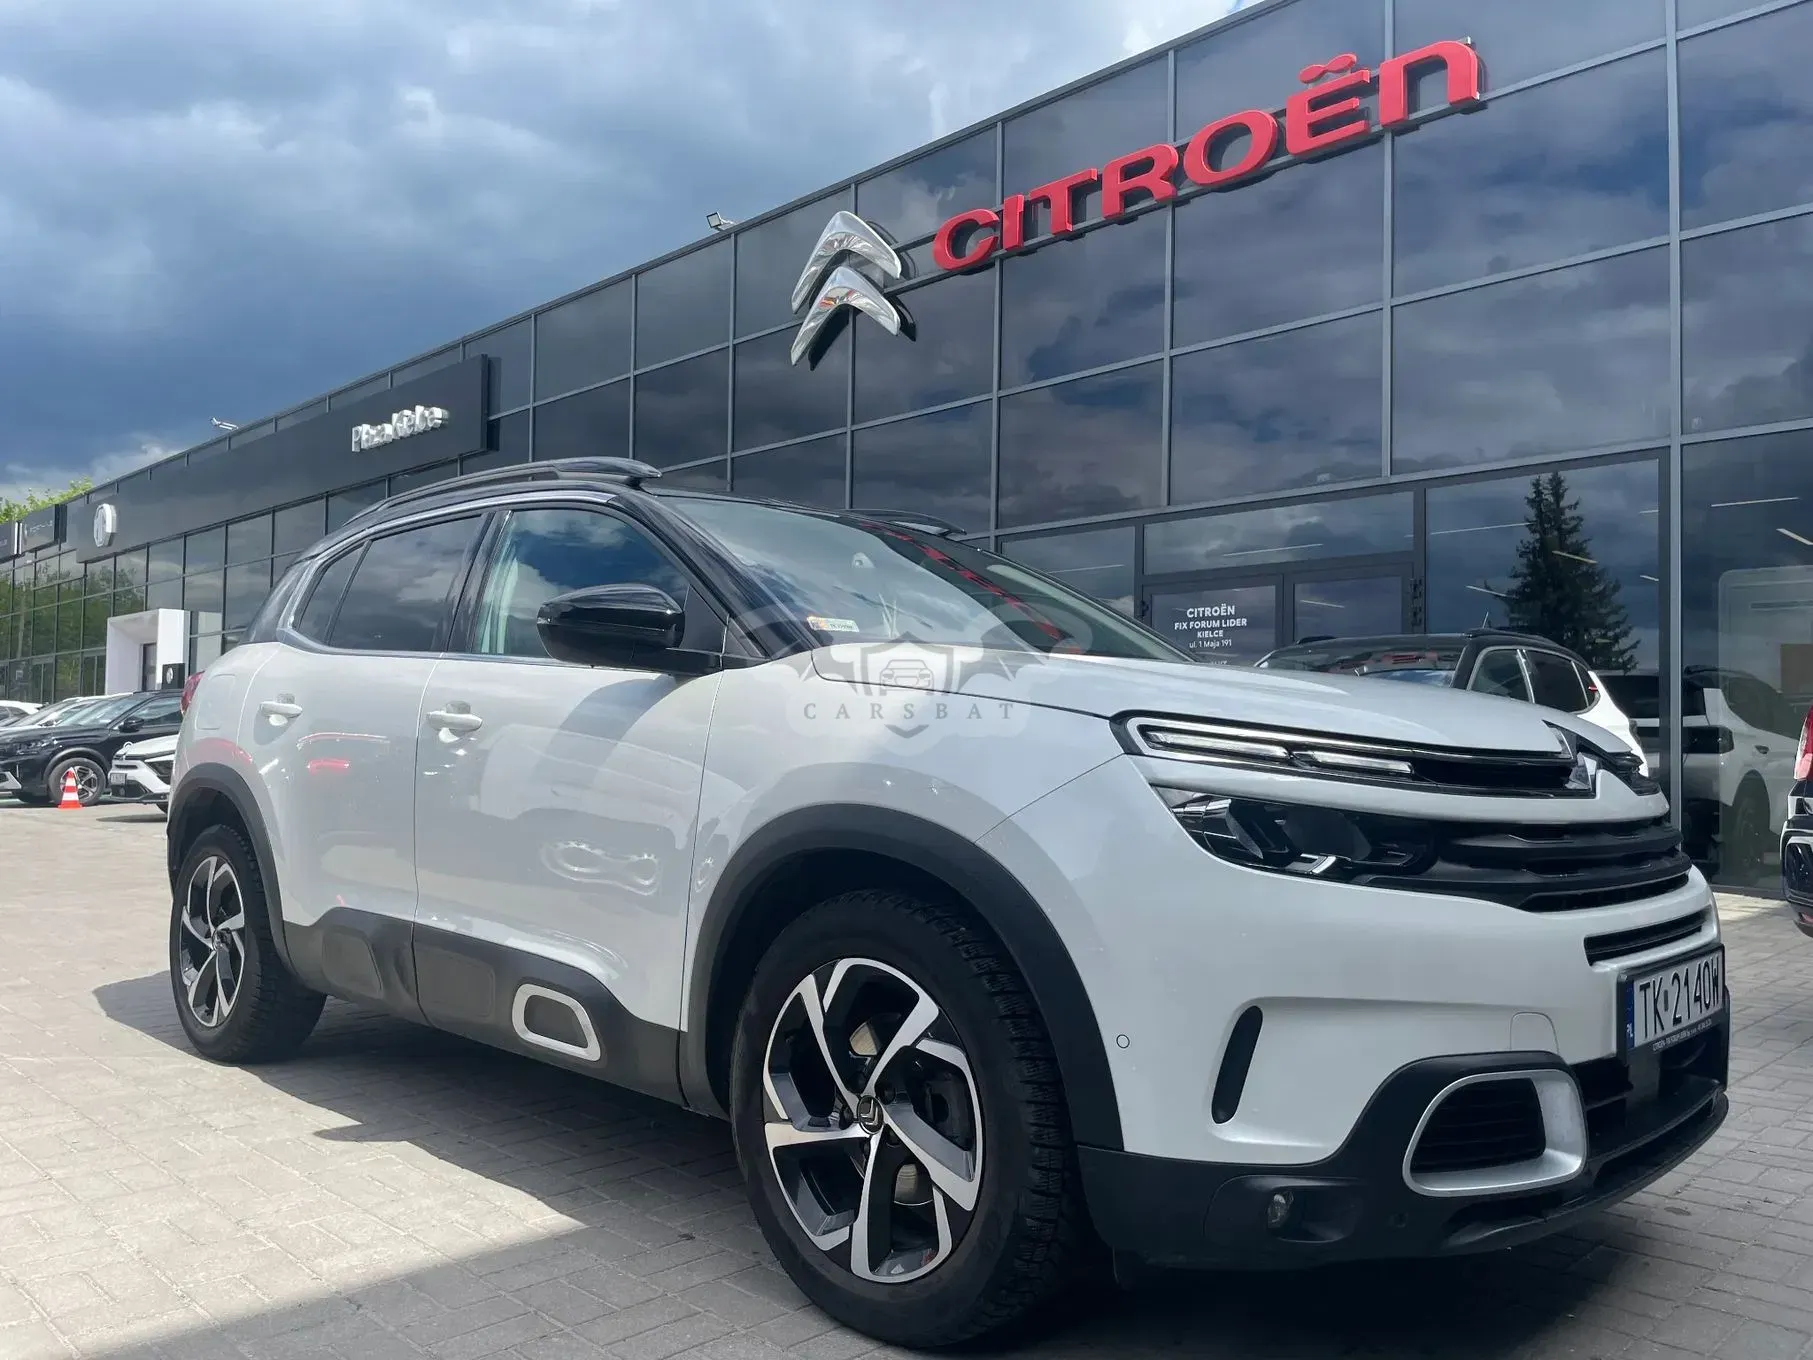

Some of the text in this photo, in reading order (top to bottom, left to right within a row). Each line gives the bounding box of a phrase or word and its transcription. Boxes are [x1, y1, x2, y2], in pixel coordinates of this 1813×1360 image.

[932, 40, 1479, 271] CITROËN
[1186, 603, 1235, 617] CITROËN
[1174, 618, 1247, 630] FIX FORUM LIDER
[1197, 630, 1224, 638] KIELCE
[1203, 640, 1220, 649] Maja
[1221, 639, 1232, 647] 191
